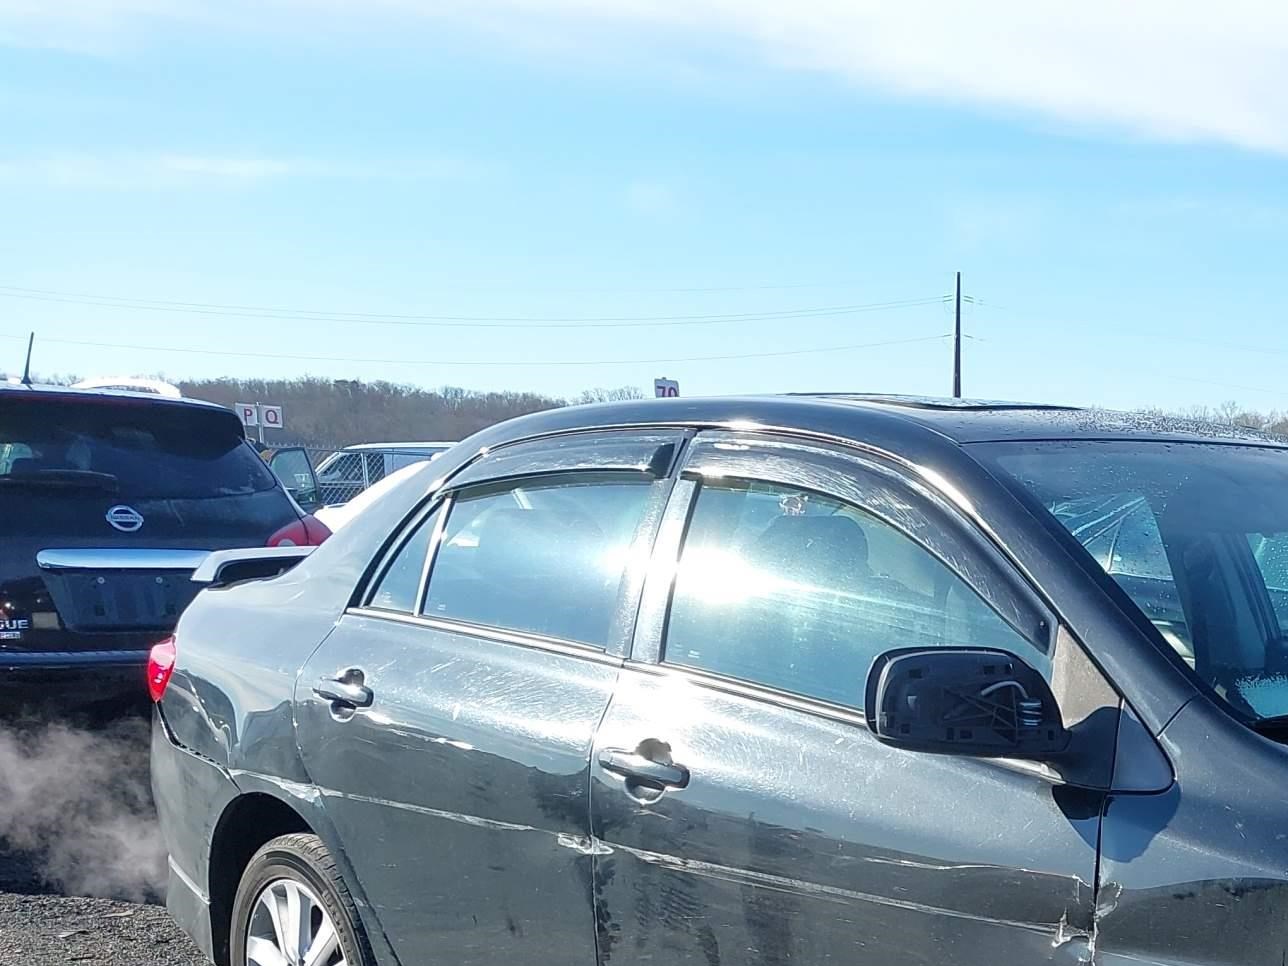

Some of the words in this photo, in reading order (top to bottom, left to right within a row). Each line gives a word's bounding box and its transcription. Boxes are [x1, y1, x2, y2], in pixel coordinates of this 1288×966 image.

[656, 385, 678, 398] 70
[244, 408, 253, 424] P
[265, 409, 280, 424] Q
